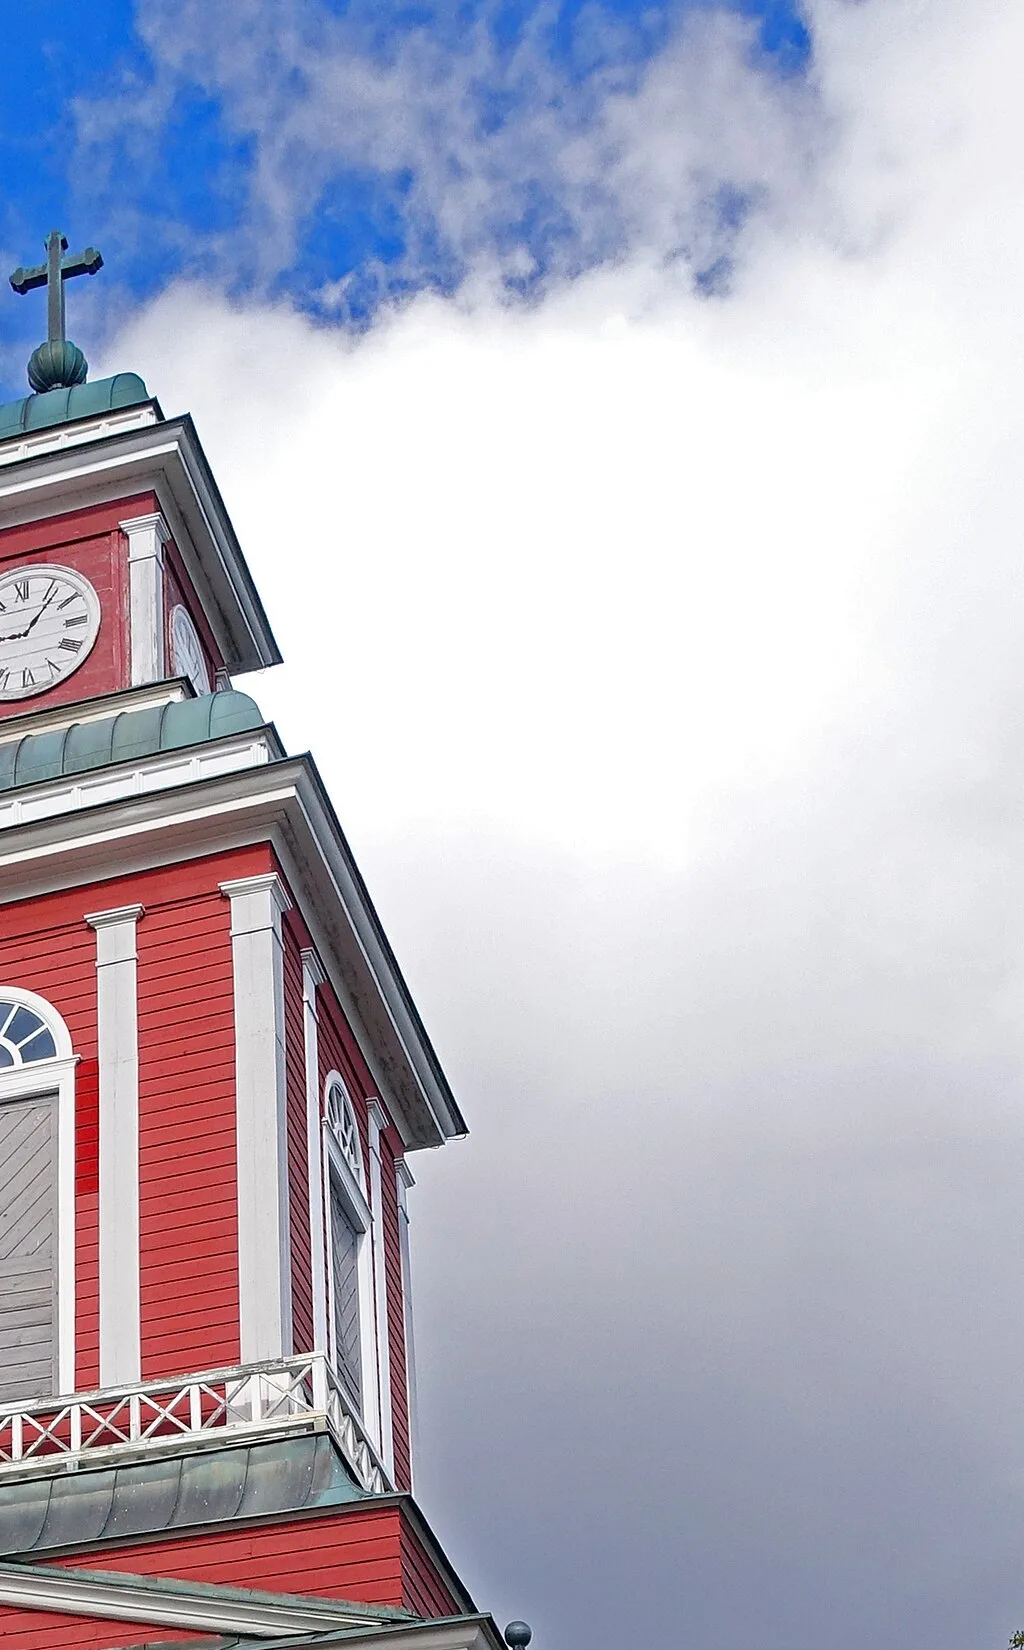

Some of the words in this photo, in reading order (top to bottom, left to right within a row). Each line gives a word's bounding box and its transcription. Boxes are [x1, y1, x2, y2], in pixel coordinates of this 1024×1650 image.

[15, 581, 29, 602] XII
[57, 592, 82, 610] II
[63, 614, 88, 628] III
[22, 667, 35, 688] VI
[45, 658, 62, 678] V
